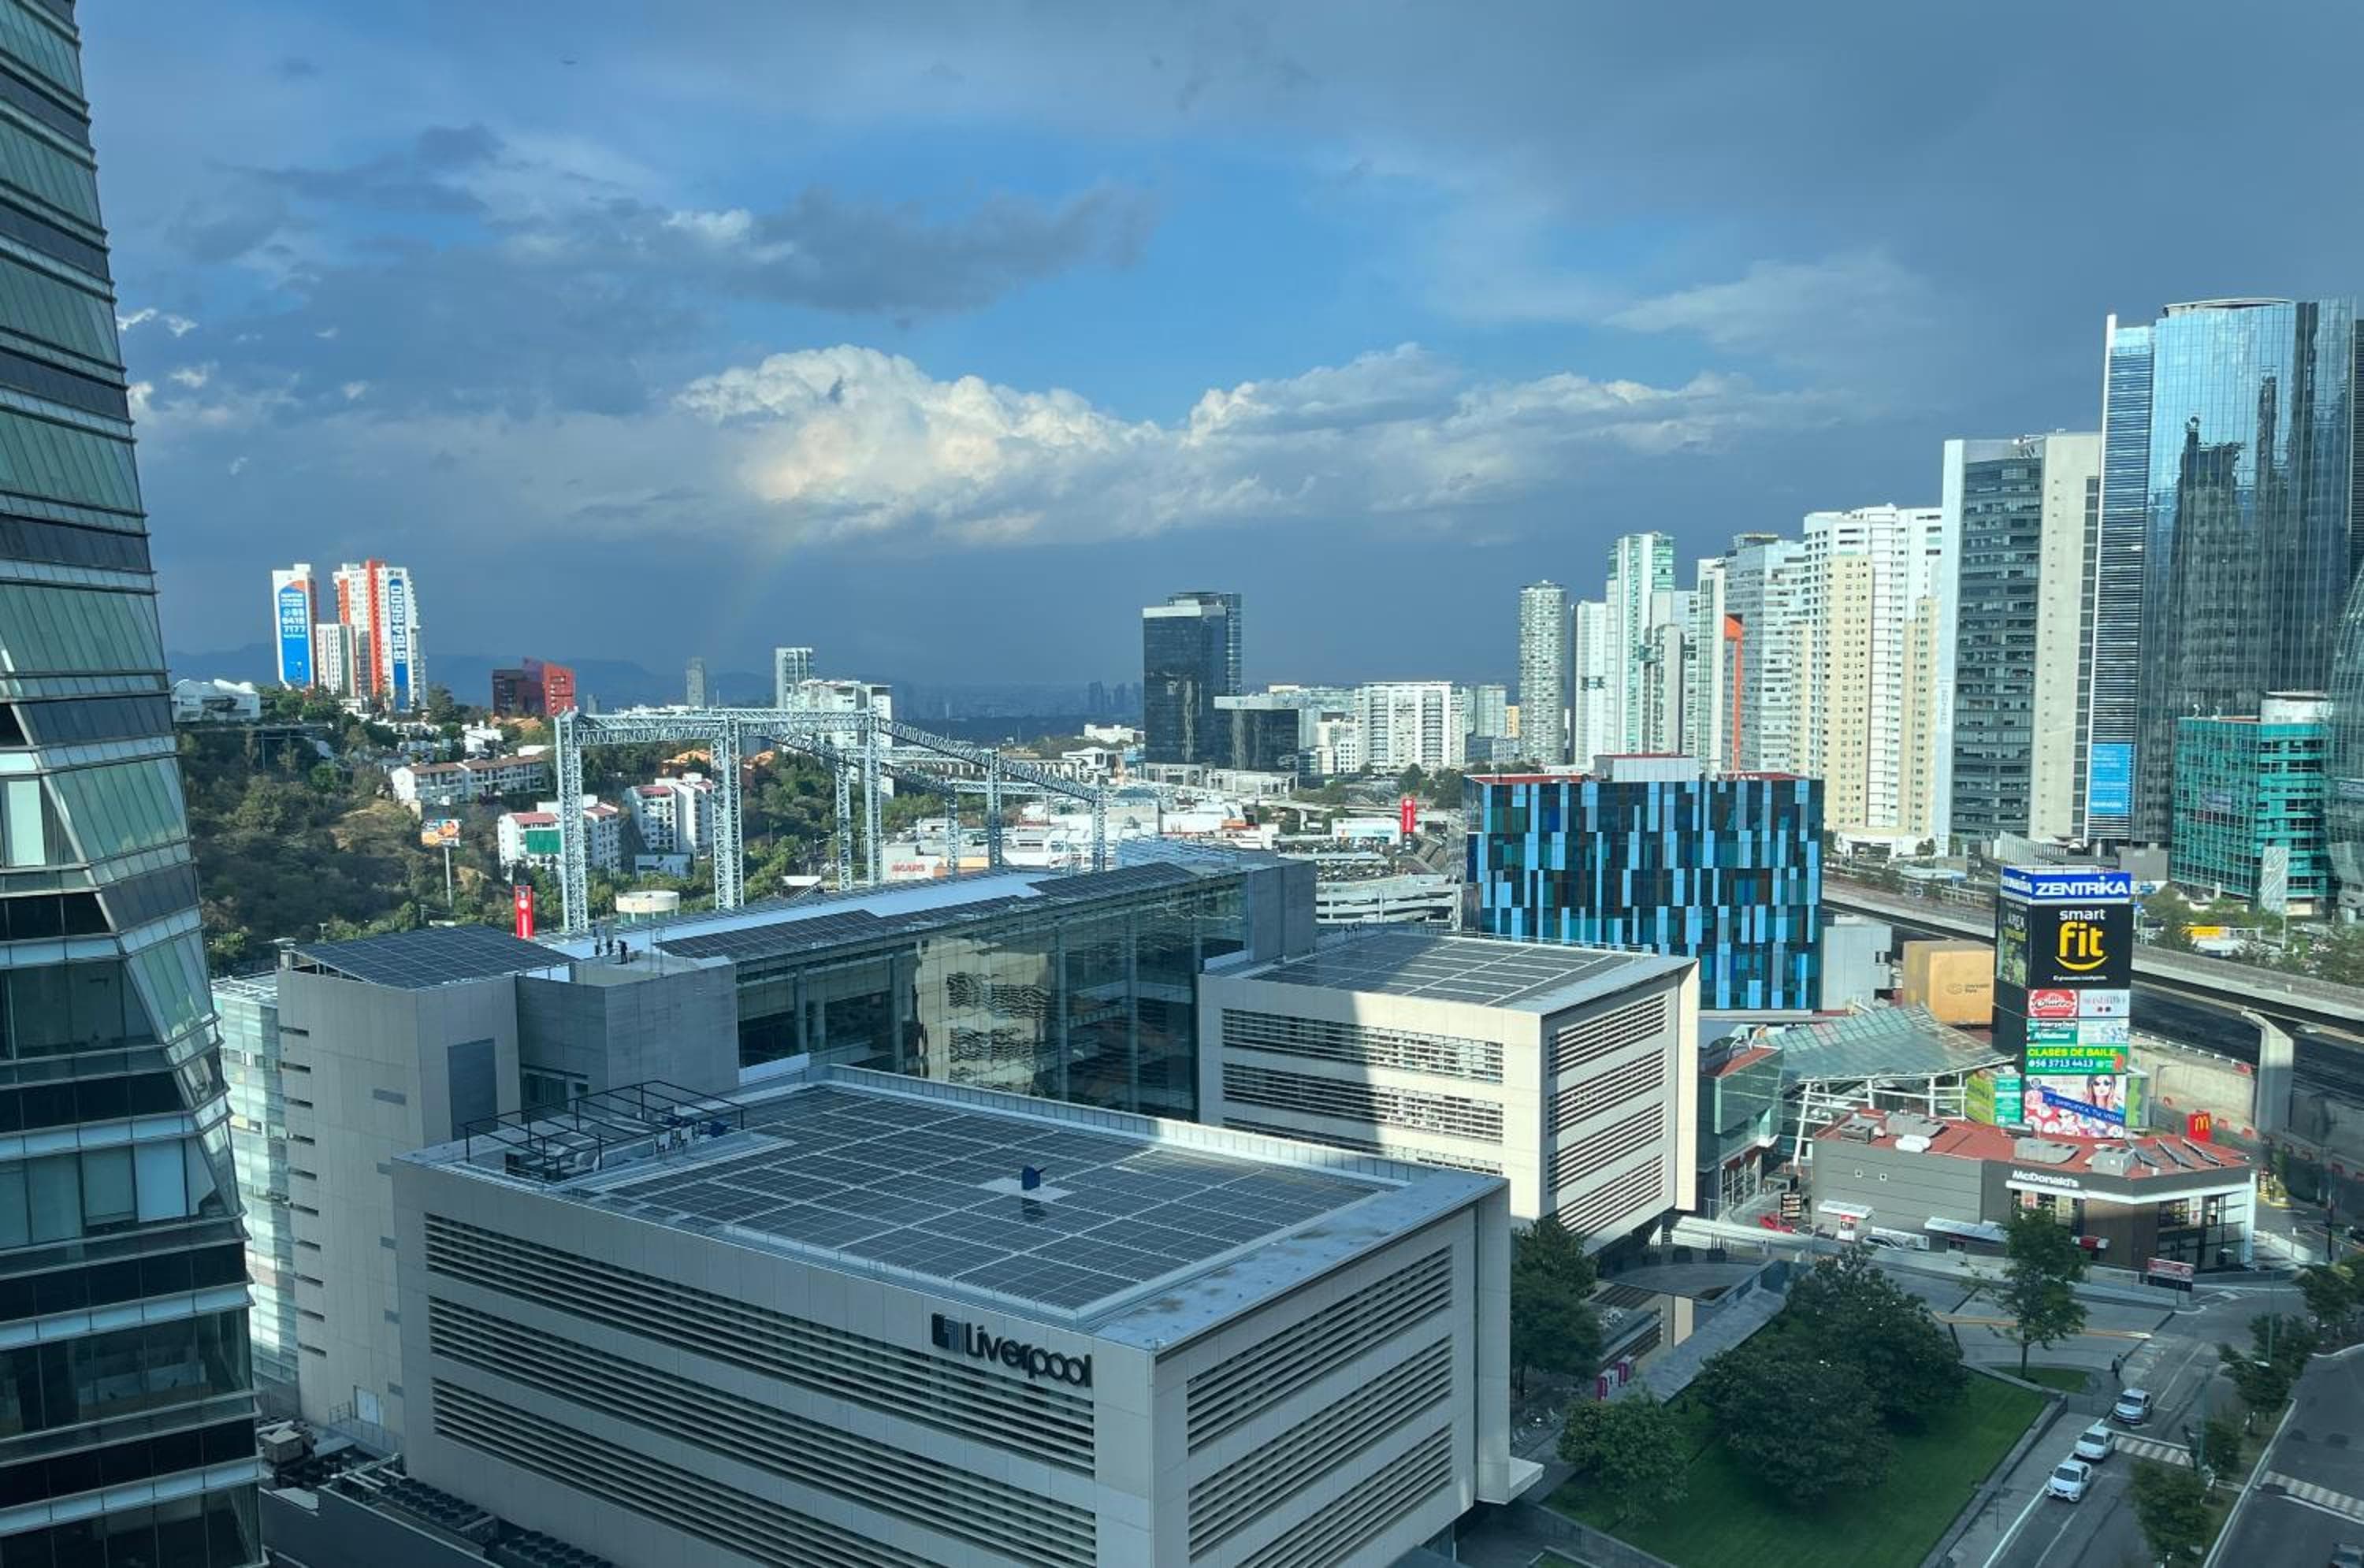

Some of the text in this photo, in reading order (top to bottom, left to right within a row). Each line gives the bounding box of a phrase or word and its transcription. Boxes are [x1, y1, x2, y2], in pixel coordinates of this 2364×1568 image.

[2035, 875, 2128, 896] ZENTRIKA
[2059, 908, 2106, 921] smart
[2059, 921, 2104, 958] fit
[2028, 1047, 2118, 1057] CLASES DE BAILE
[2012, 1170, 2080, 1187] McDonald's
[965, 1322, 1091, 1388] Liverpool
